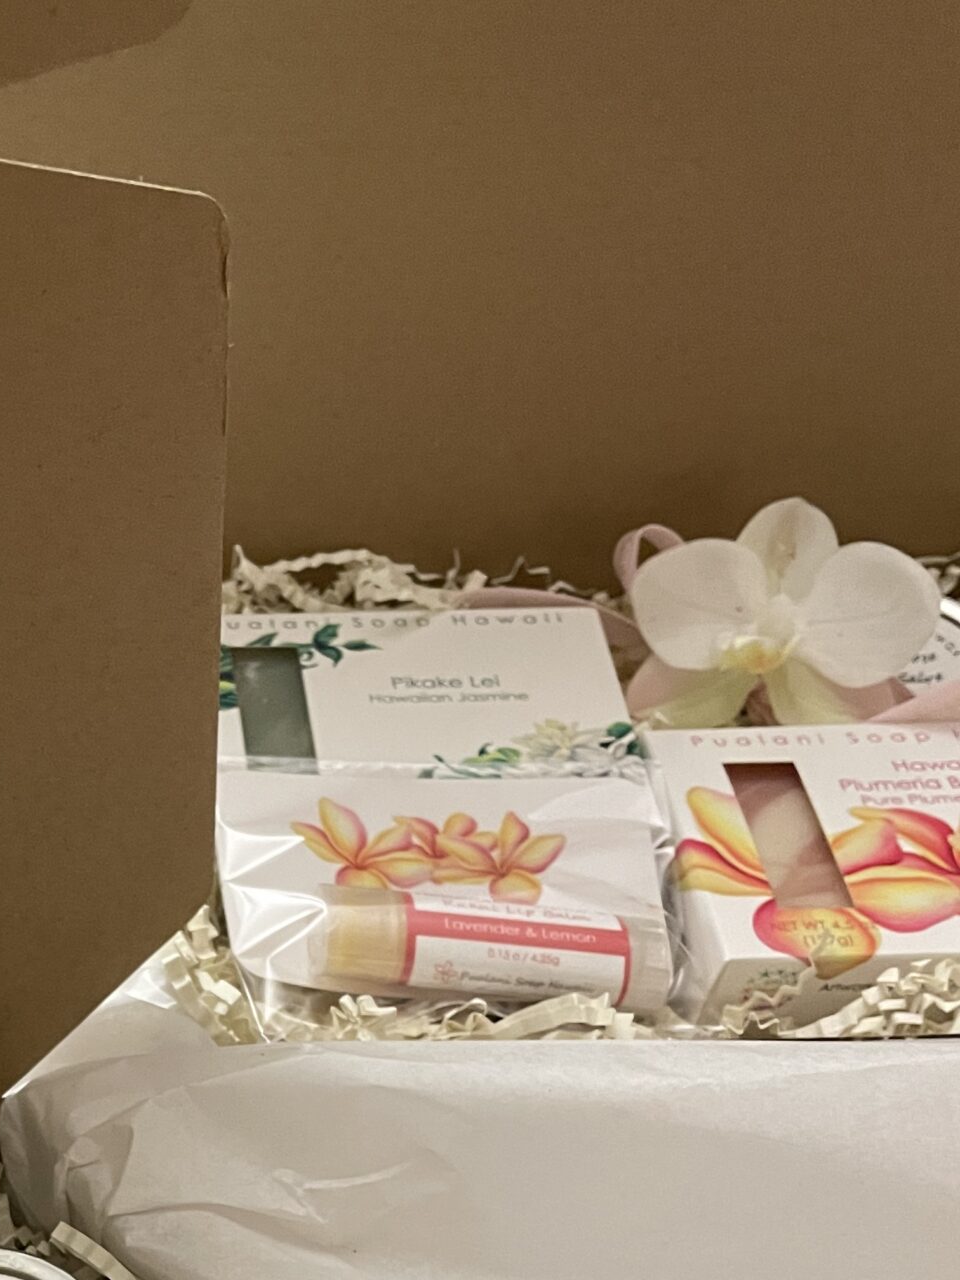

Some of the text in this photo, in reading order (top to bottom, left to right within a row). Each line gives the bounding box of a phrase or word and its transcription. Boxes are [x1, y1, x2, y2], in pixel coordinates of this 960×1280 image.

[226, 613, 564, 630] ualani Soap Hawaii
[391, 674, 501, 690] Pikake Lei
[369, 691, 530, 704] Hawaiian Jasmine
[691, 732, 930, 747] Pualani Soap
[891, 760, 960, 771] Hawa
[839, 779, 941, 791] Plumeria
[907, 794, 960, 804] Plume
[445, 918, 596, 943] Lavender & Lemon
